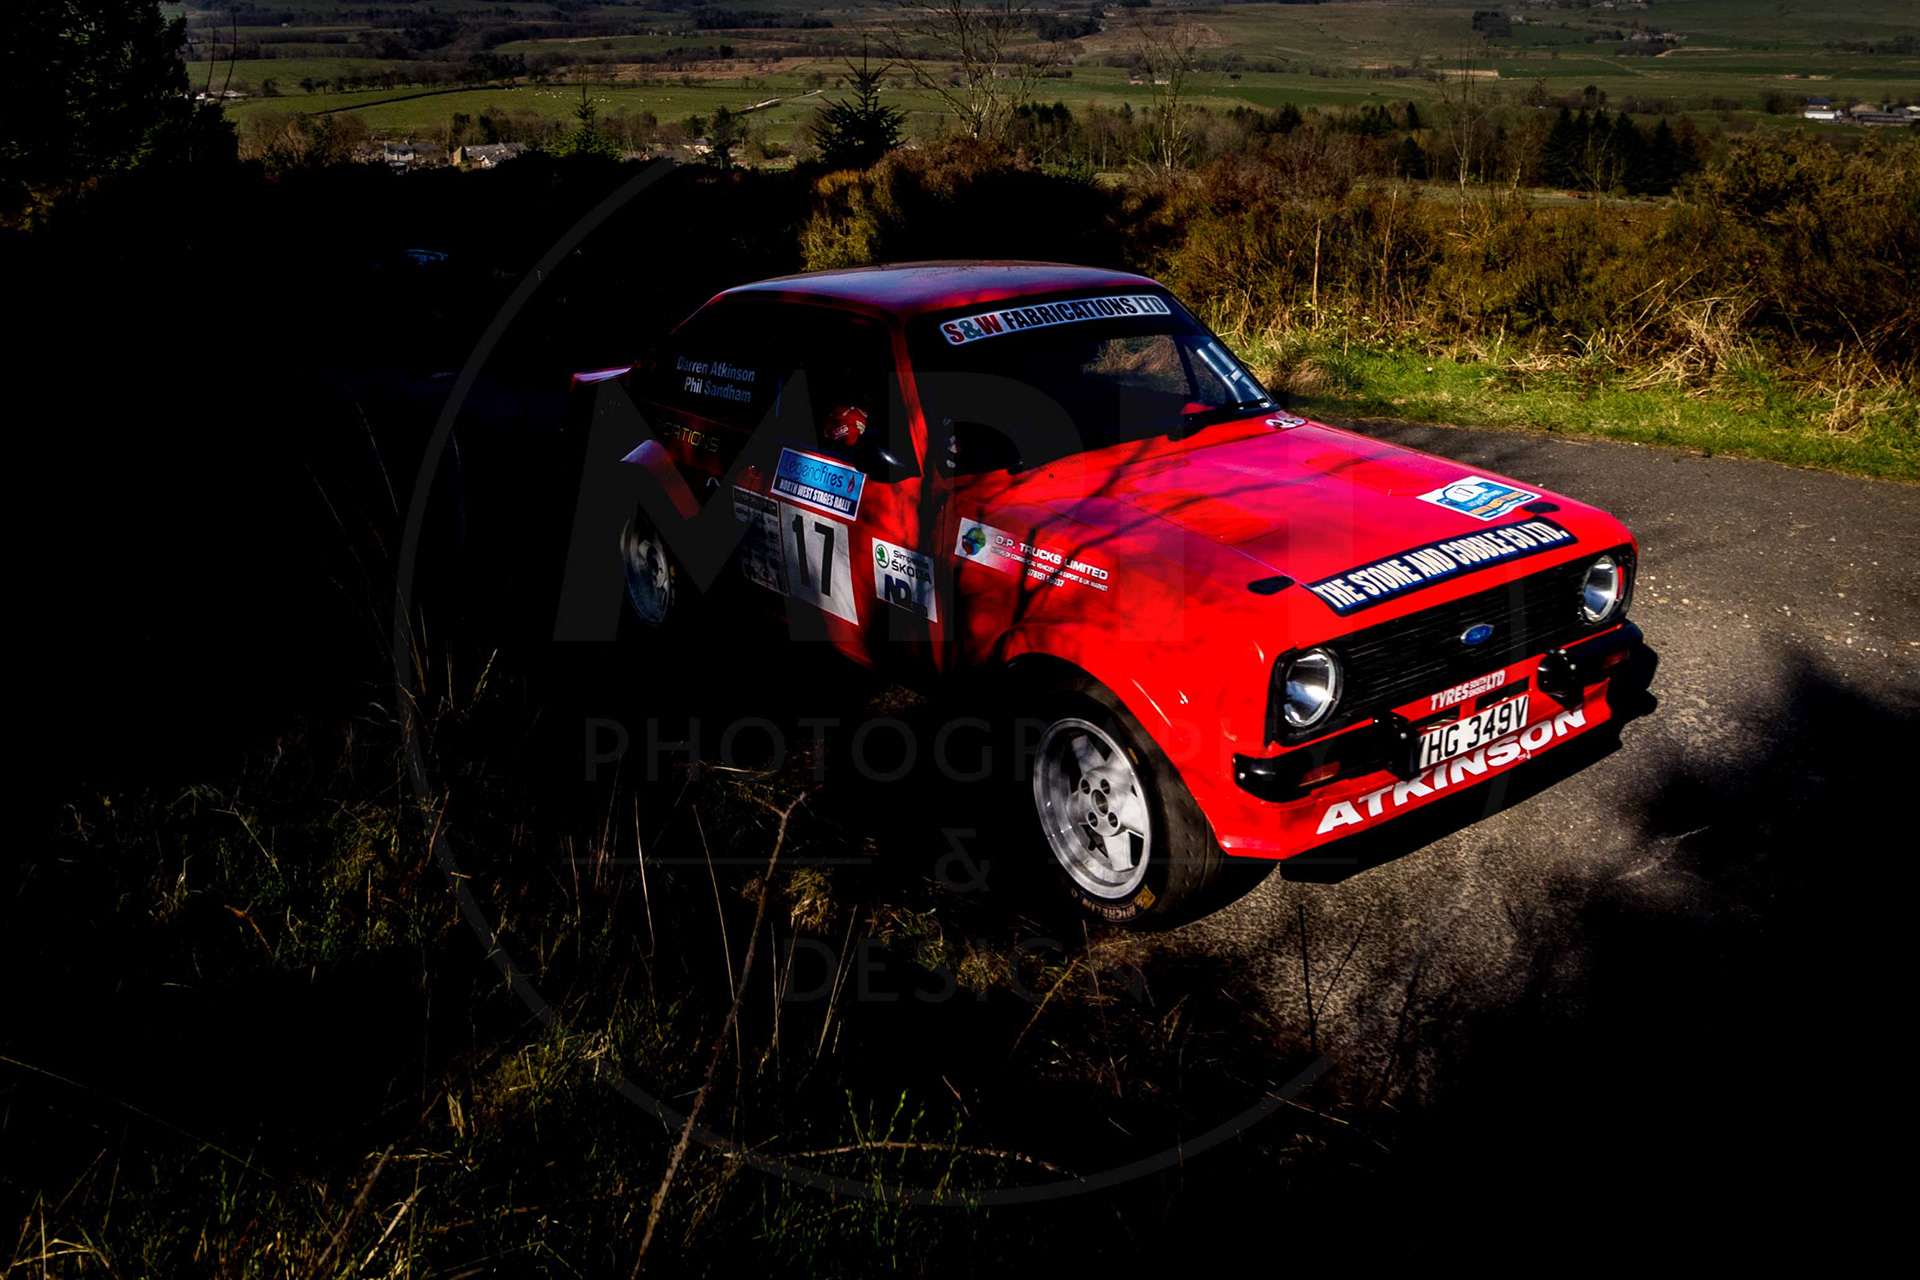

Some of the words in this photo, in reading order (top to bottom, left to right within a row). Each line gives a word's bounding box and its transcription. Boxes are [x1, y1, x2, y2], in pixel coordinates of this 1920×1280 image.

[942, 313, 1004, 343] S&W
[1004, 297, 1137, 331] FABRICATIONS
[1134, 296, 1165, 313] LTD
[676, 356, 708, 375] Darren
[709, 361, 756, 382] Atkinson
[684, 376, 703, 394] Phil
[704, 380, 752, 403] Sandham
[778, 478, 798, 494] NORTH
[797, 484, 813, 500] WEST
[812, 489, 834, 507] STAGES
[833, 496, 852, 512] RALLY
[792, 514, 834, 597] 17
[1019, 542, 1062, 565] TRUCKS
[1064, 557, 1109, 581] LIMITED
[1312, 577, 1365, 610] THE
[1348, 555, 1425, 599] STONE
[1402, 547, 1458, 580] AND
[1439, 530, 1519, 567] COBBLE
[1496, 526, 1538, 550] CO
[1431, 682, 1469, 711] TYRES
[1486, 669, 1506, 692] LTD
[1466, 695, 1530, 749] 349V
[1316, 709, 1587, 835] ATKINSON
